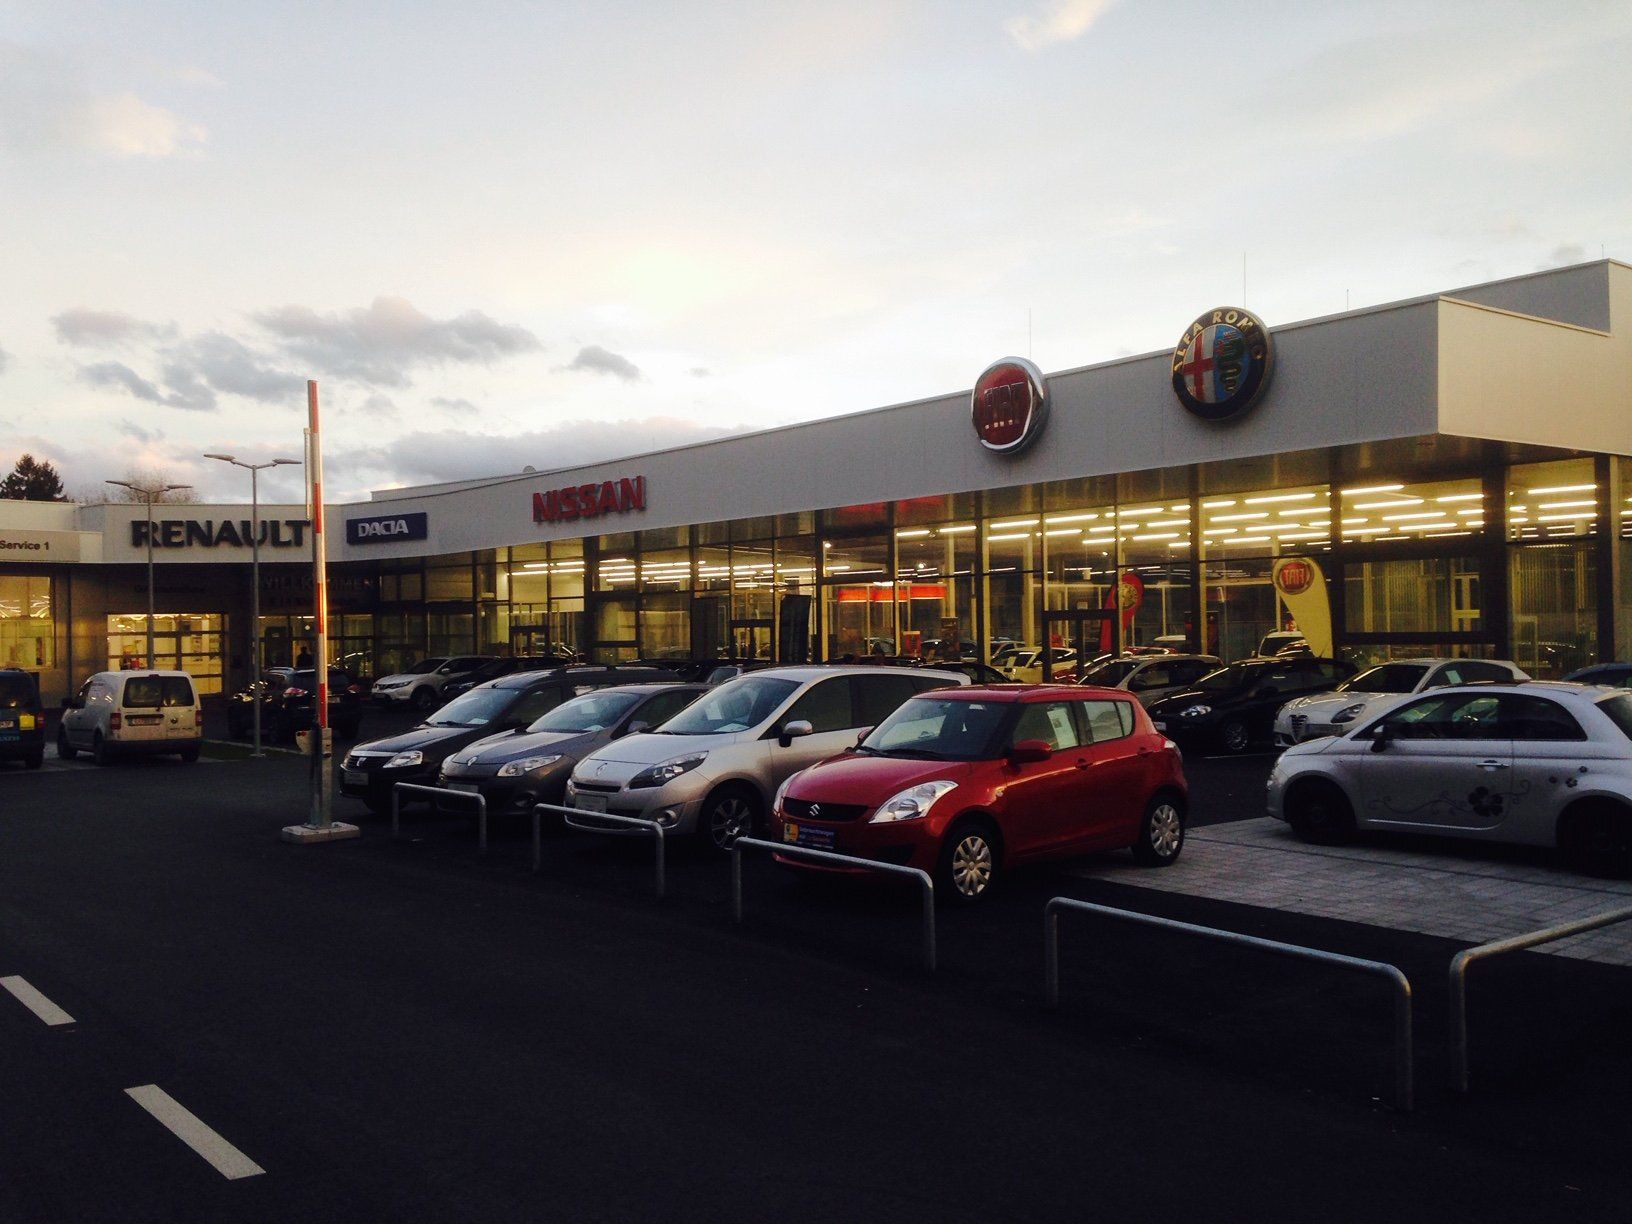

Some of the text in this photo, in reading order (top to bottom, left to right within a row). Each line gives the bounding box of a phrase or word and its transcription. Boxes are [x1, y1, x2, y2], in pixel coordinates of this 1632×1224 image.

[1212, 309, 1265, 361] ROMO
[532, 475, 647, 524] NISSAN
[131, 520, 311, 547] RENAULT
[357, 519, 409, 538] DACIA
[0, 540, 50, 551] Service 1
